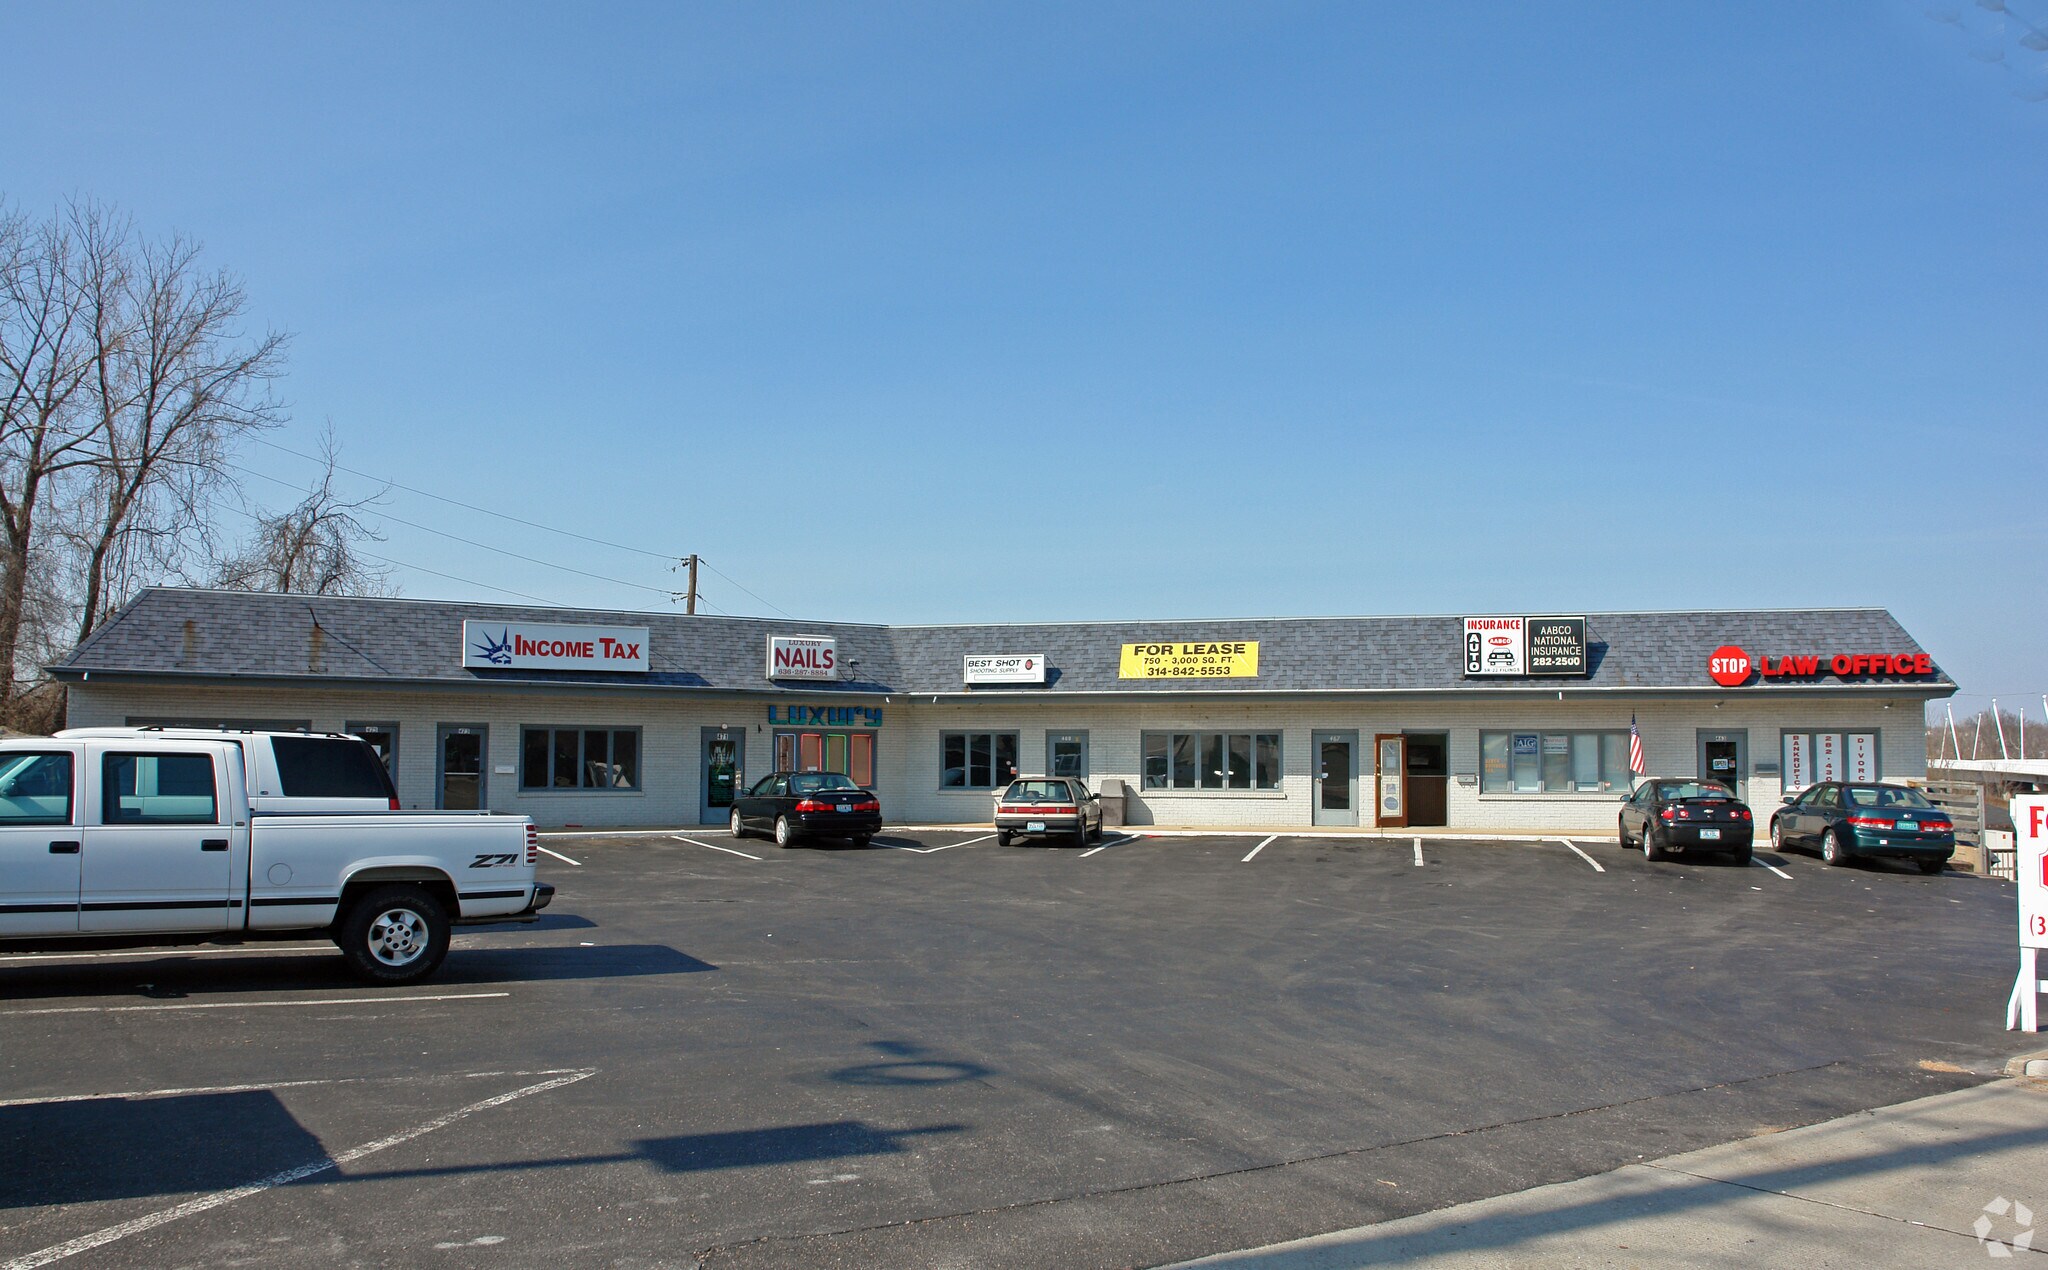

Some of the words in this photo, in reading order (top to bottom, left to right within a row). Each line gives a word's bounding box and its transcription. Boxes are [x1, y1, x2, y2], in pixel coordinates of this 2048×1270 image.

[1467, 620, 1520, 630] INSURANCE
[1540, 626, 1572, 635] AABCO
[514, 634, 594, 658] INCOME
[599, 638, 640, 660] TAX
[1534, 637, 1578, 646] NATIONAL
[1134, 645, 1173, 656] FOR
[1183, 644, 1246, 655] LEASE
[1469, 634, 1479, 671] AUTO
[1531, 646, 1582, 656] INSURANCE
[775, 647, 834, 669] NAILS
[995, 659, 1021, 667] SHOT
[1144, 657, 1161, 665] 750
[1171, 656, 1199, 665] 3,000
[1202, 656, 1217, 664] SQ.
[1221, 656, 1235, 664] FT.
[1533, 657, 1580, 666] 282-2500
[1711, 658, 1747, 673] STOP
[1760, 656, 1820, 676] LAW
[1830, 654, 1933, 675] OFFICE
[1147, 666, 1231, 676] 314-842-5553
[1517, 739, 1535, 747] AIG
[1857, 738, 1865, 781] DIVORC
[2029, 806, 2048, 838] F
[468, 853, 519, 868] Z71
